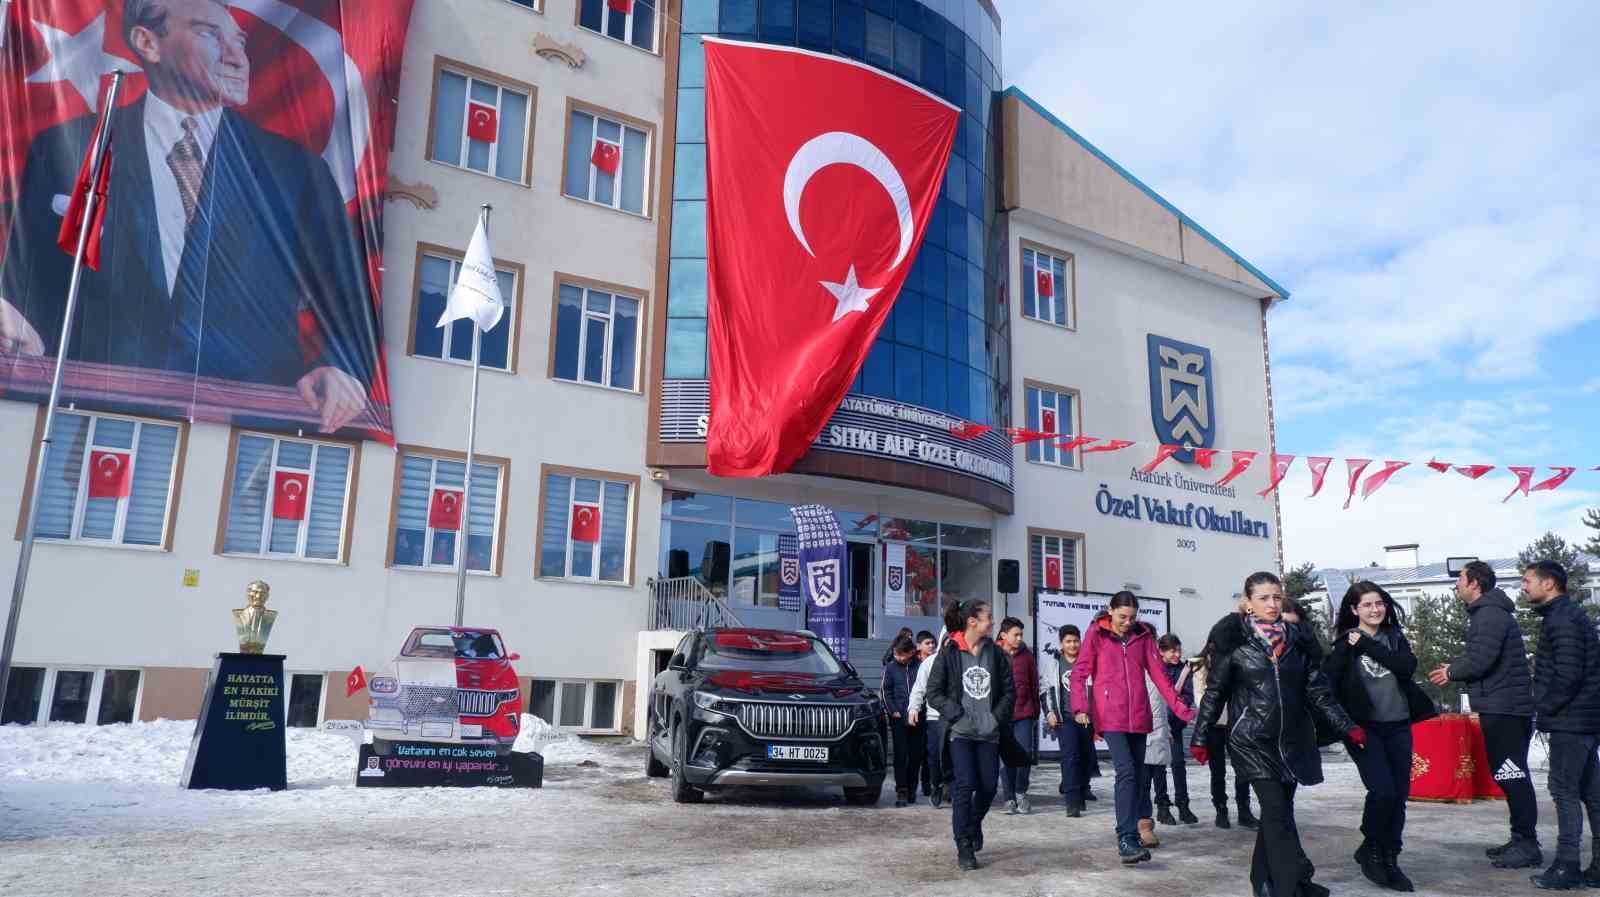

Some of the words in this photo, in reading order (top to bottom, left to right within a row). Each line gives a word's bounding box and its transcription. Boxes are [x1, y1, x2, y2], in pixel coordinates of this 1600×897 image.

[883, 433, 914, 457] ALP
[919, 433, 952, 465] ÖZEL
[1129, 466, 1173, 488] Atatürk
[1175, 472, 1236, 498] Üniversitesi
[1095, 484, 1142, 520] Özel
[1142, 496, 1195, 528] Vakıf
[1195, 506, 1269, 539] Okulları
[1176, 538, 1197, 551] 2003
[227, 674, 275, 684] HAYATTA
[223, 686, 238, 695] EN
[241, 685, 279, 696] HAKİKİ
[229, 697, 271, 710] MÜRŞİT
[773, 747, 785, 758] 34
[790, 747, 801, 759] HT
[804, 748, 826, 760] 0025
[1494, 771, 1526, 781] adidas
